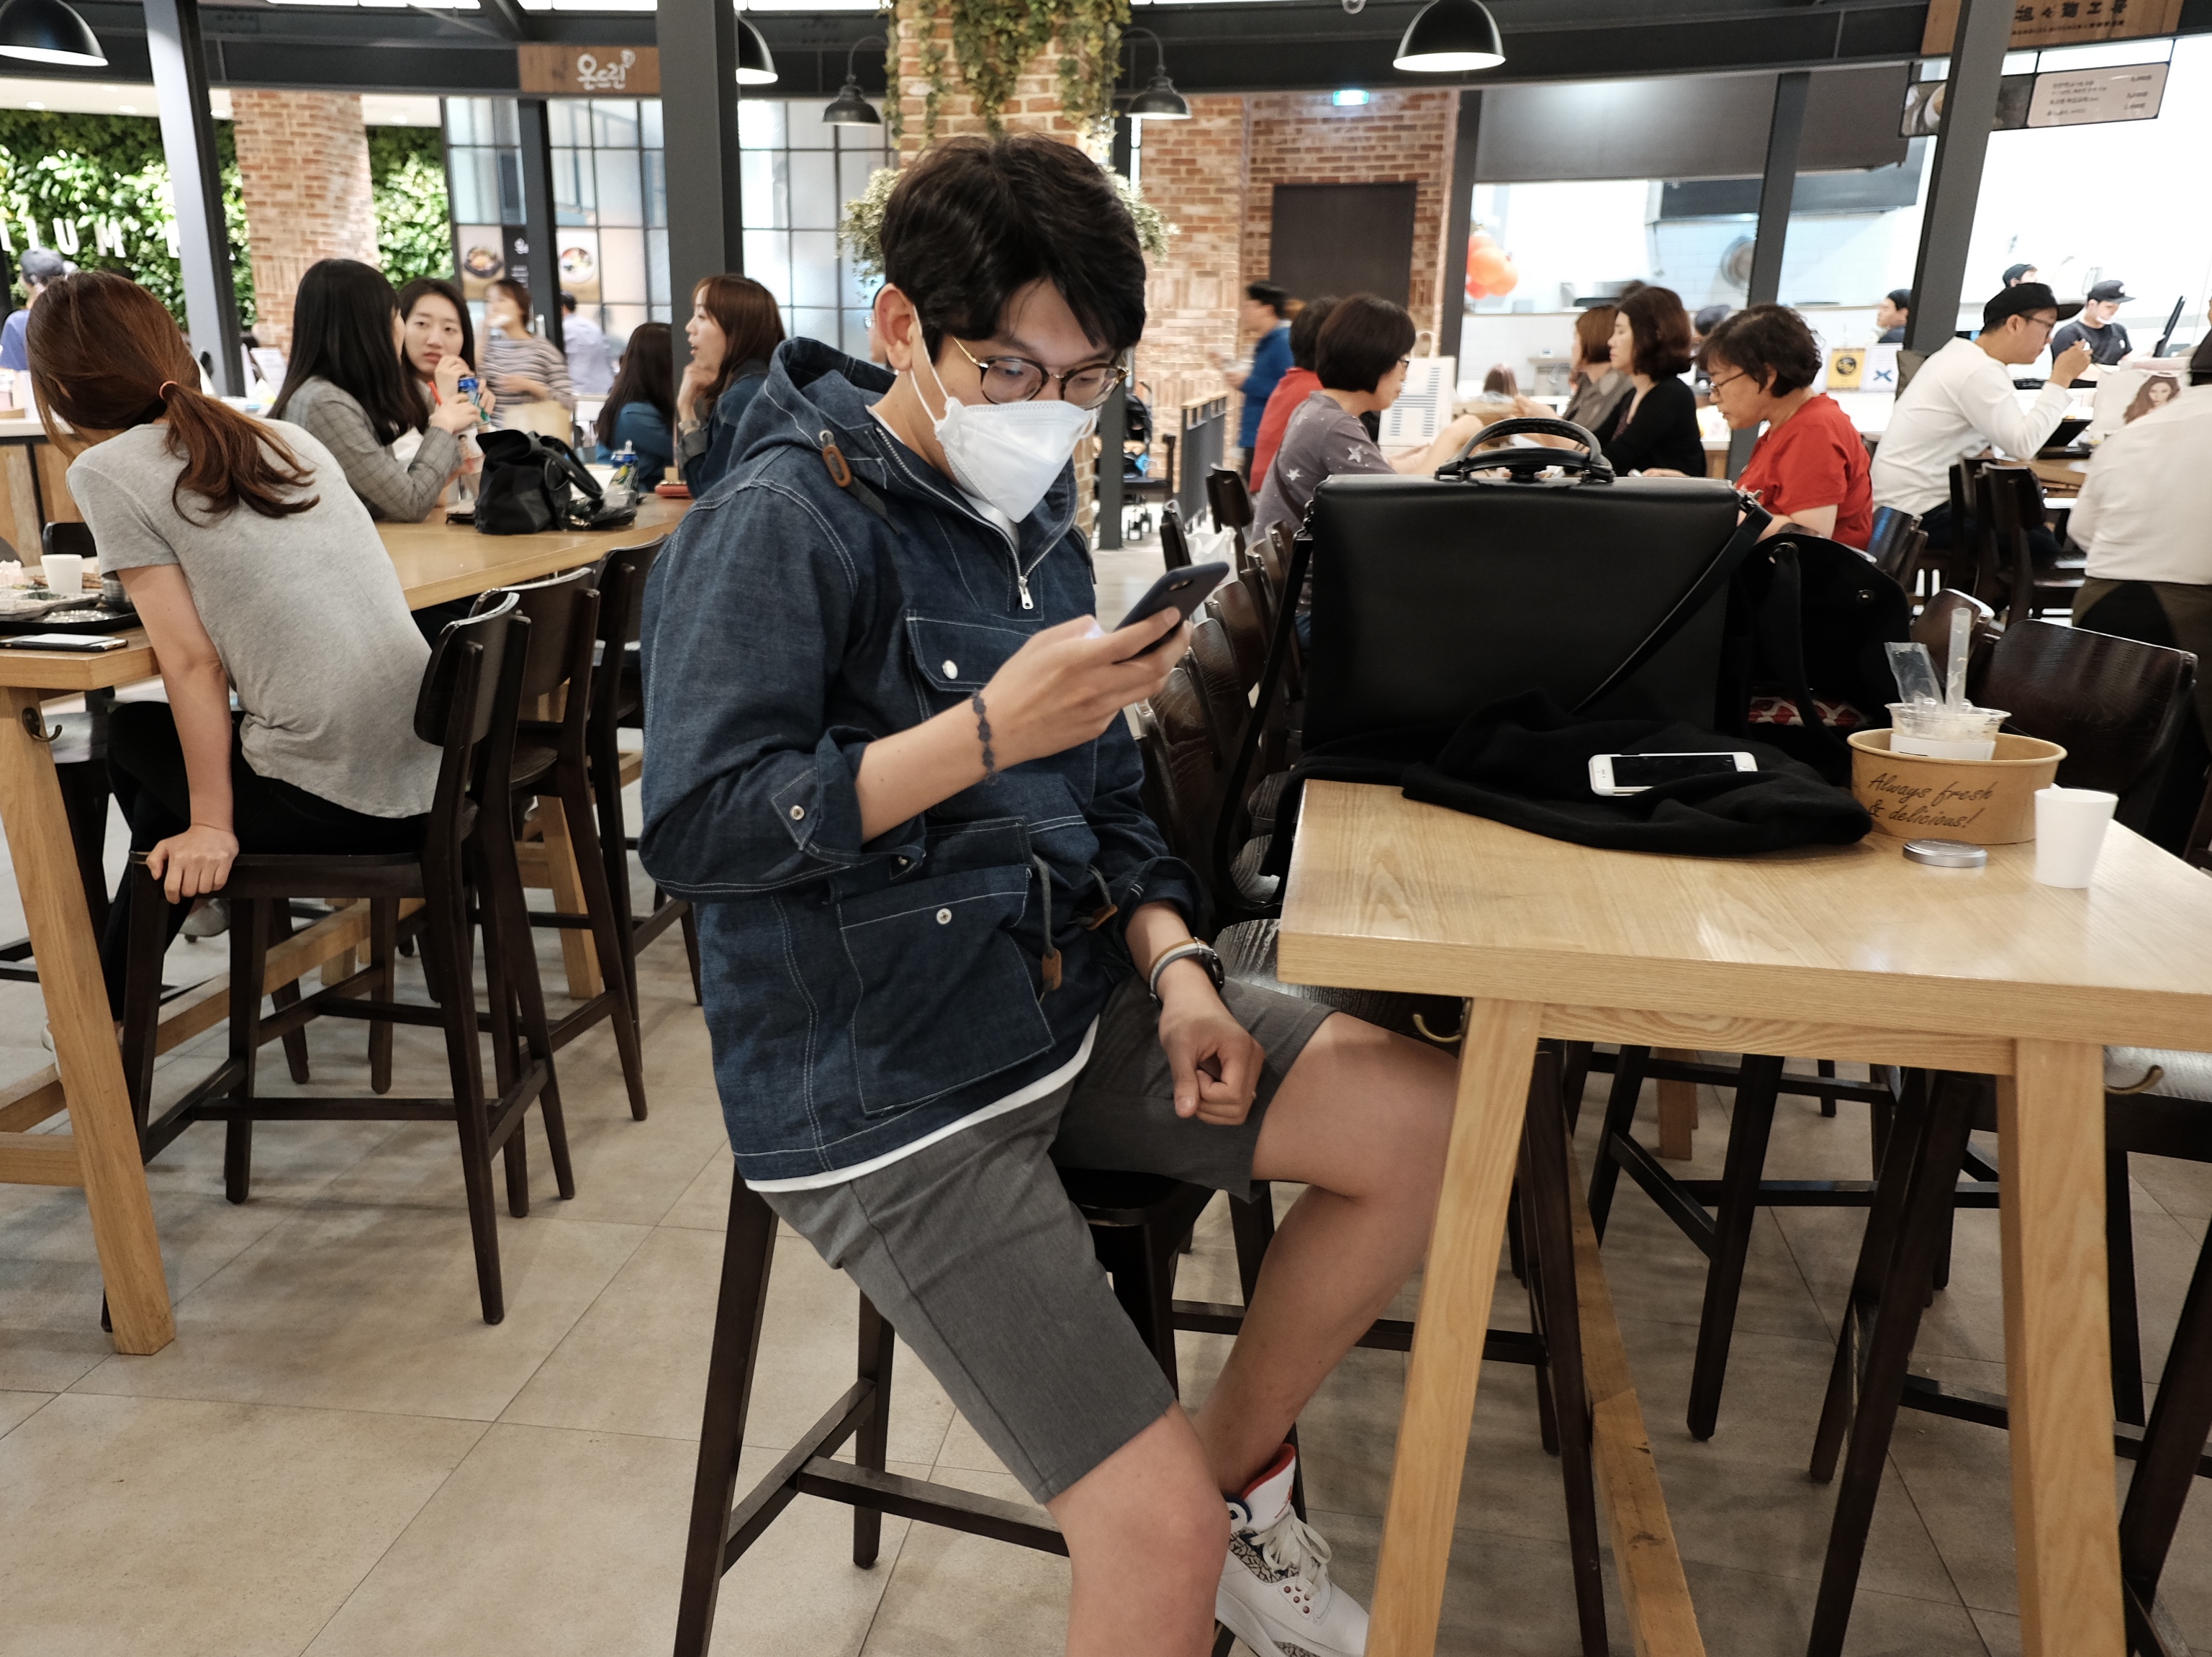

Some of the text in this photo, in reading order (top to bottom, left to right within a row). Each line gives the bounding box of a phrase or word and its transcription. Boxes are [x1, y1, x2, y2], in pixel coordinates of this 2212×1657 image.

[1868, 772, 1998, 806] Always fresh
[1869, 799, 1985, 828] & delicious!
